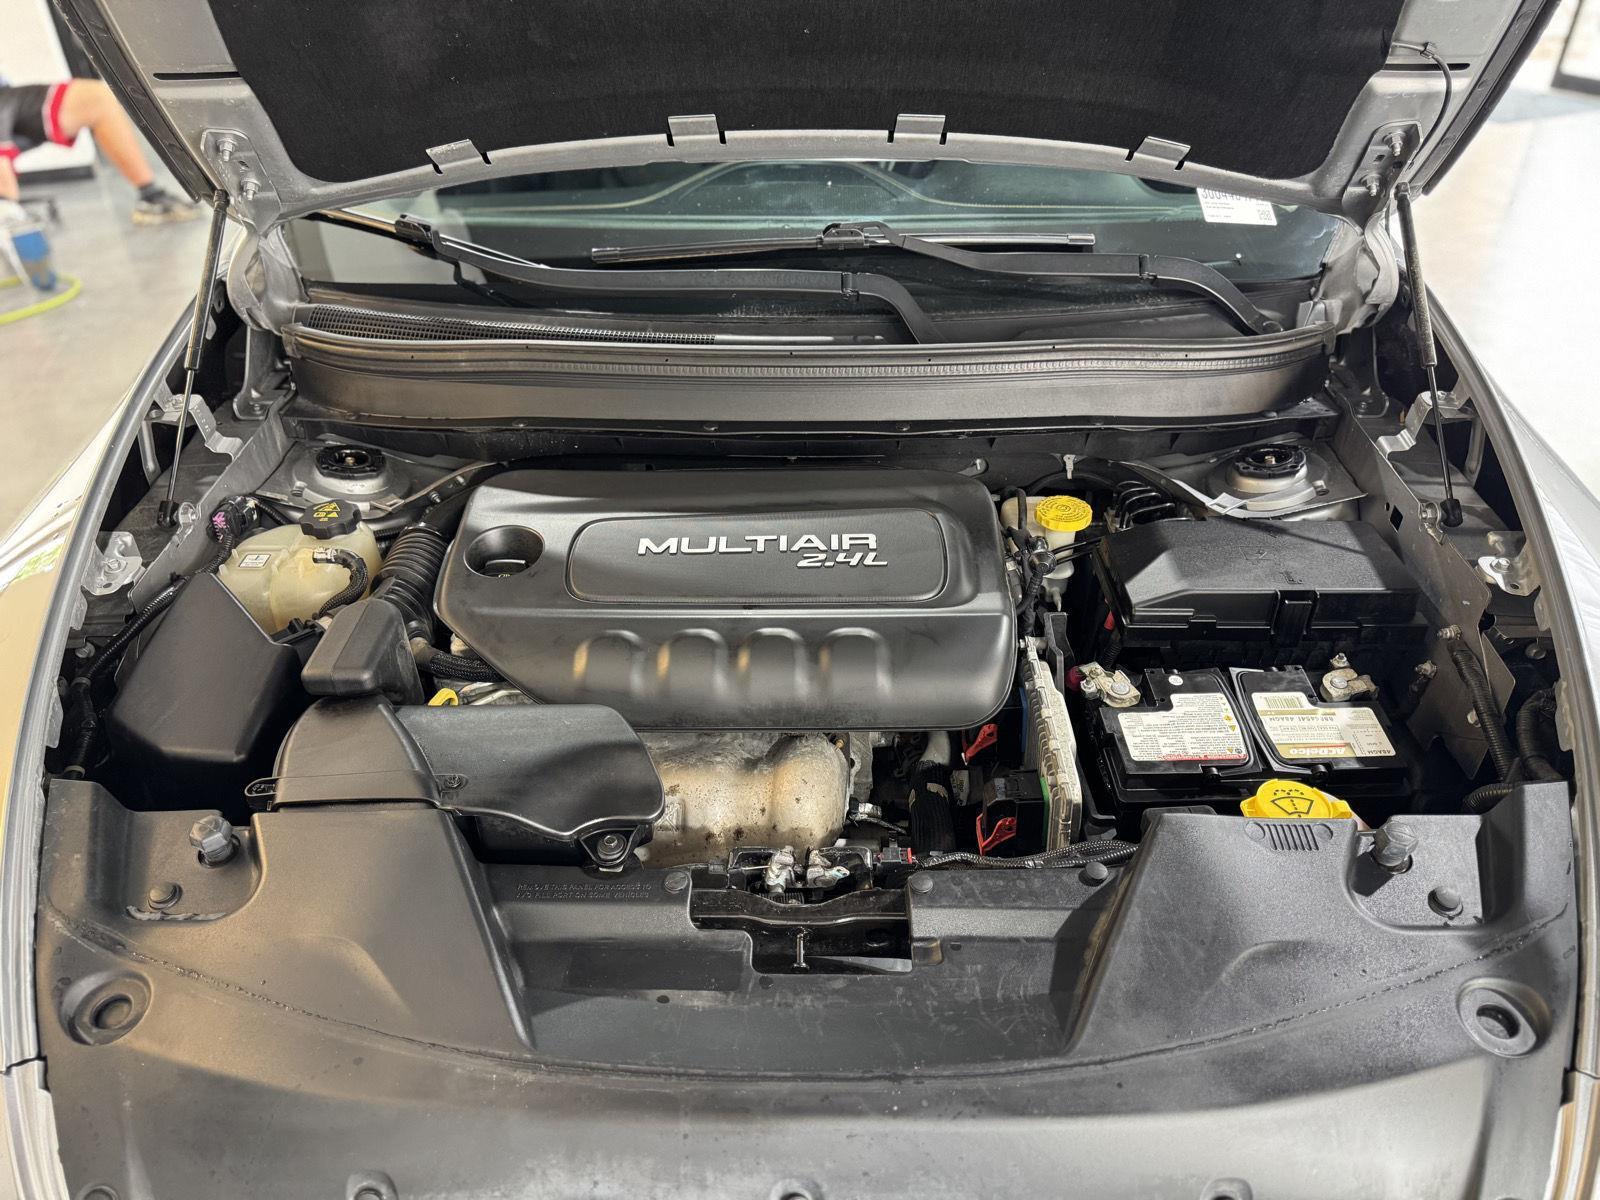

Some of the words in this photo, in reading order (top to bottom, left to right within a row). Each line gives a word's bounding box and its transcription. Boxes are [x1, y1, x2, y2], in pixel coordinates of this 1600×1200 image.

[637, 533, 877, 556] MULTIAIR
[796, 551, 889, 568] 2.4L
[1289, 747, 1346, 756] ACDelco
